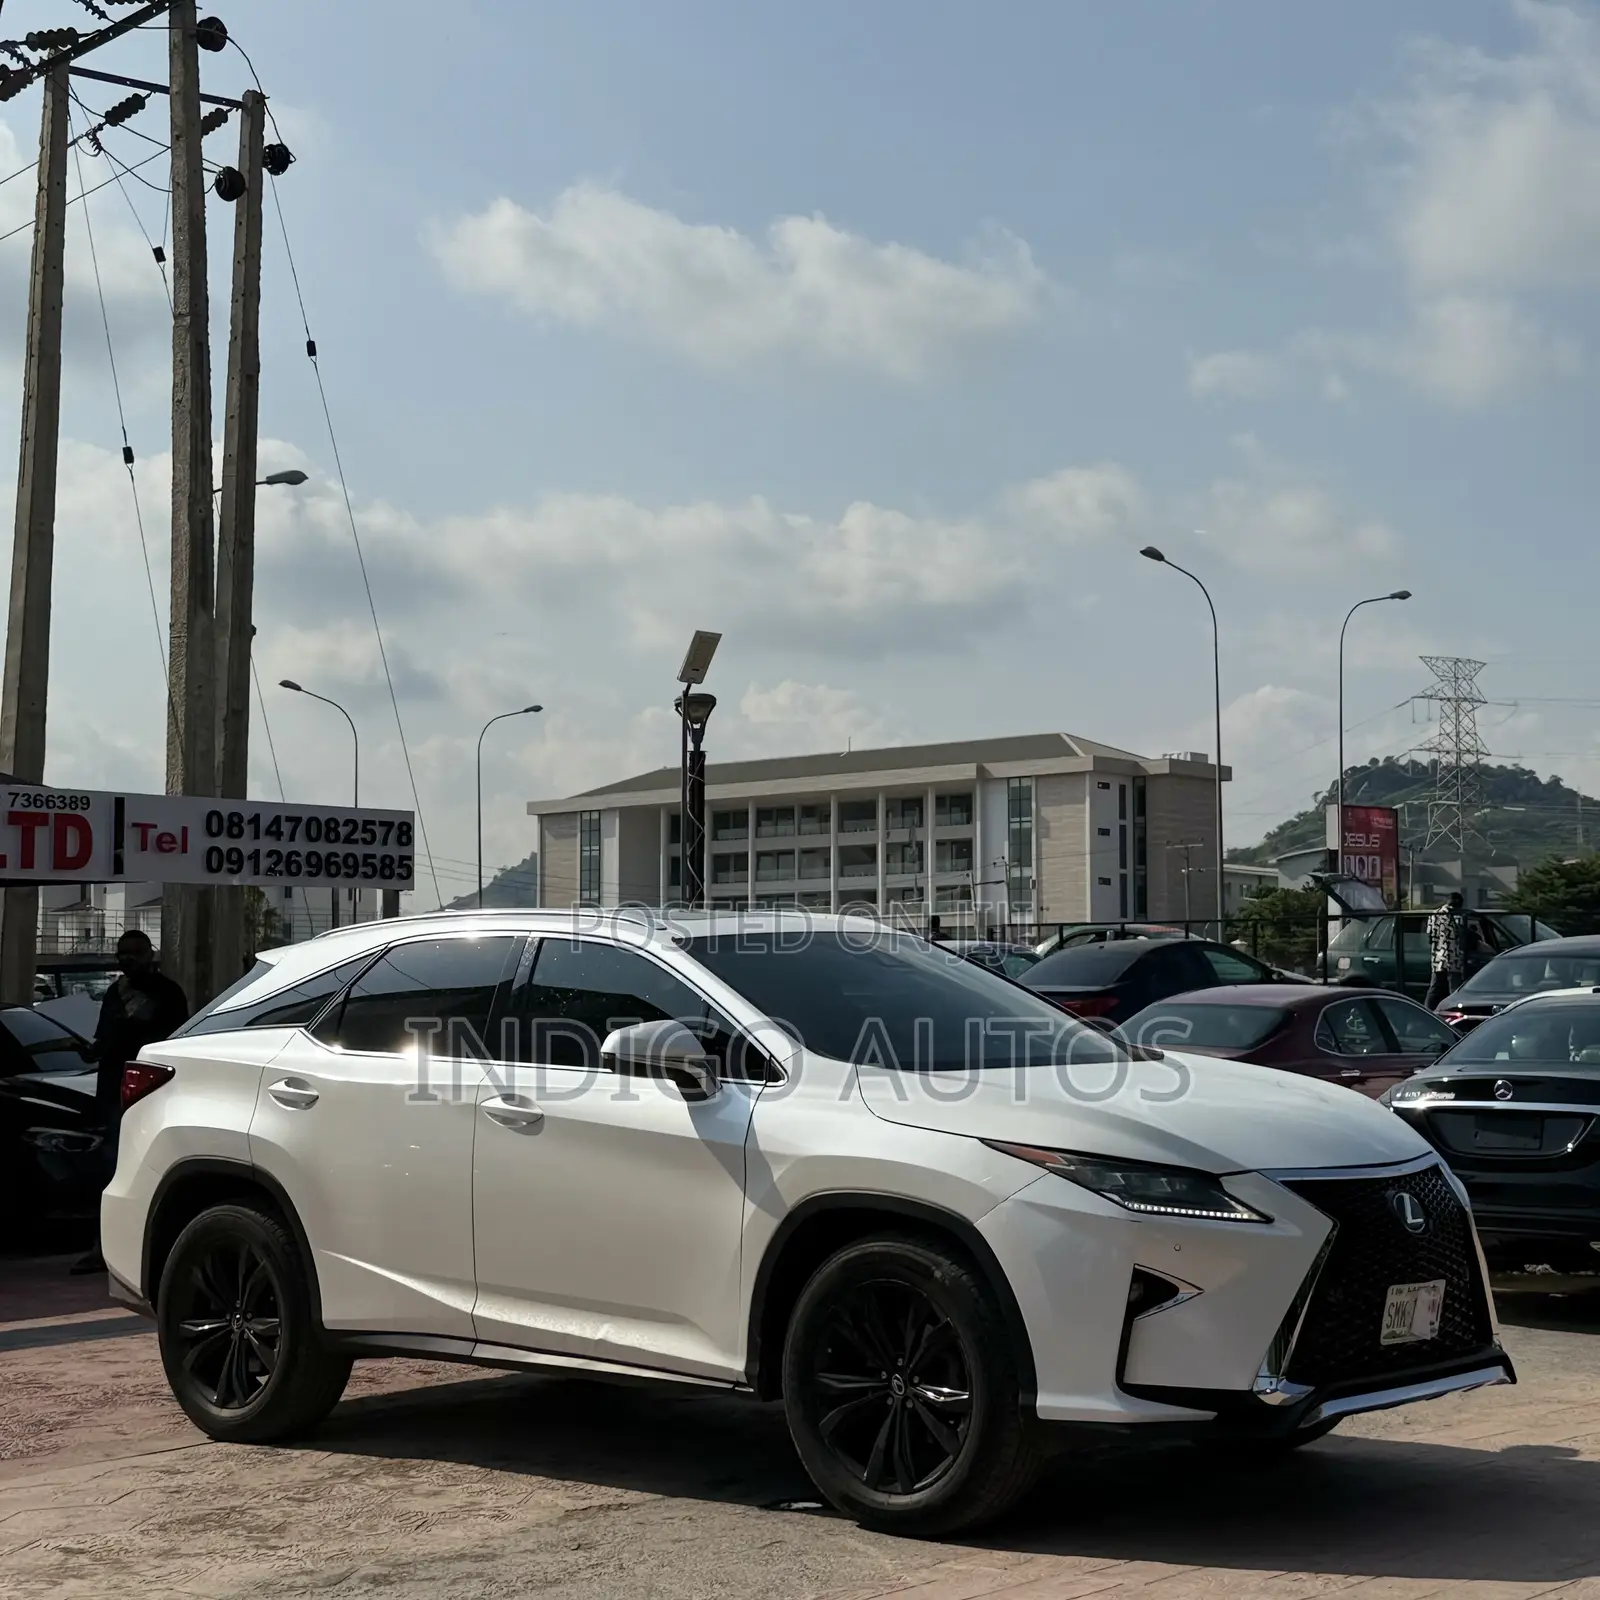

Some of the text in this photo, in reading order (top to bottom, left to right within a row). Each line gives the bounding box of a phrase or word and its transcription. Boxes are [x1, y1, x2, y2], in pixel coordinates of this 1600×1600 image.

[7, 792, 91, 811] 7366389
[0, 811, 93, 870] TD
[131, 821, 189, 854] Tel
[205, 809, 413, 847] 08147082578
[205, 845, 413, 880] 09126969585
